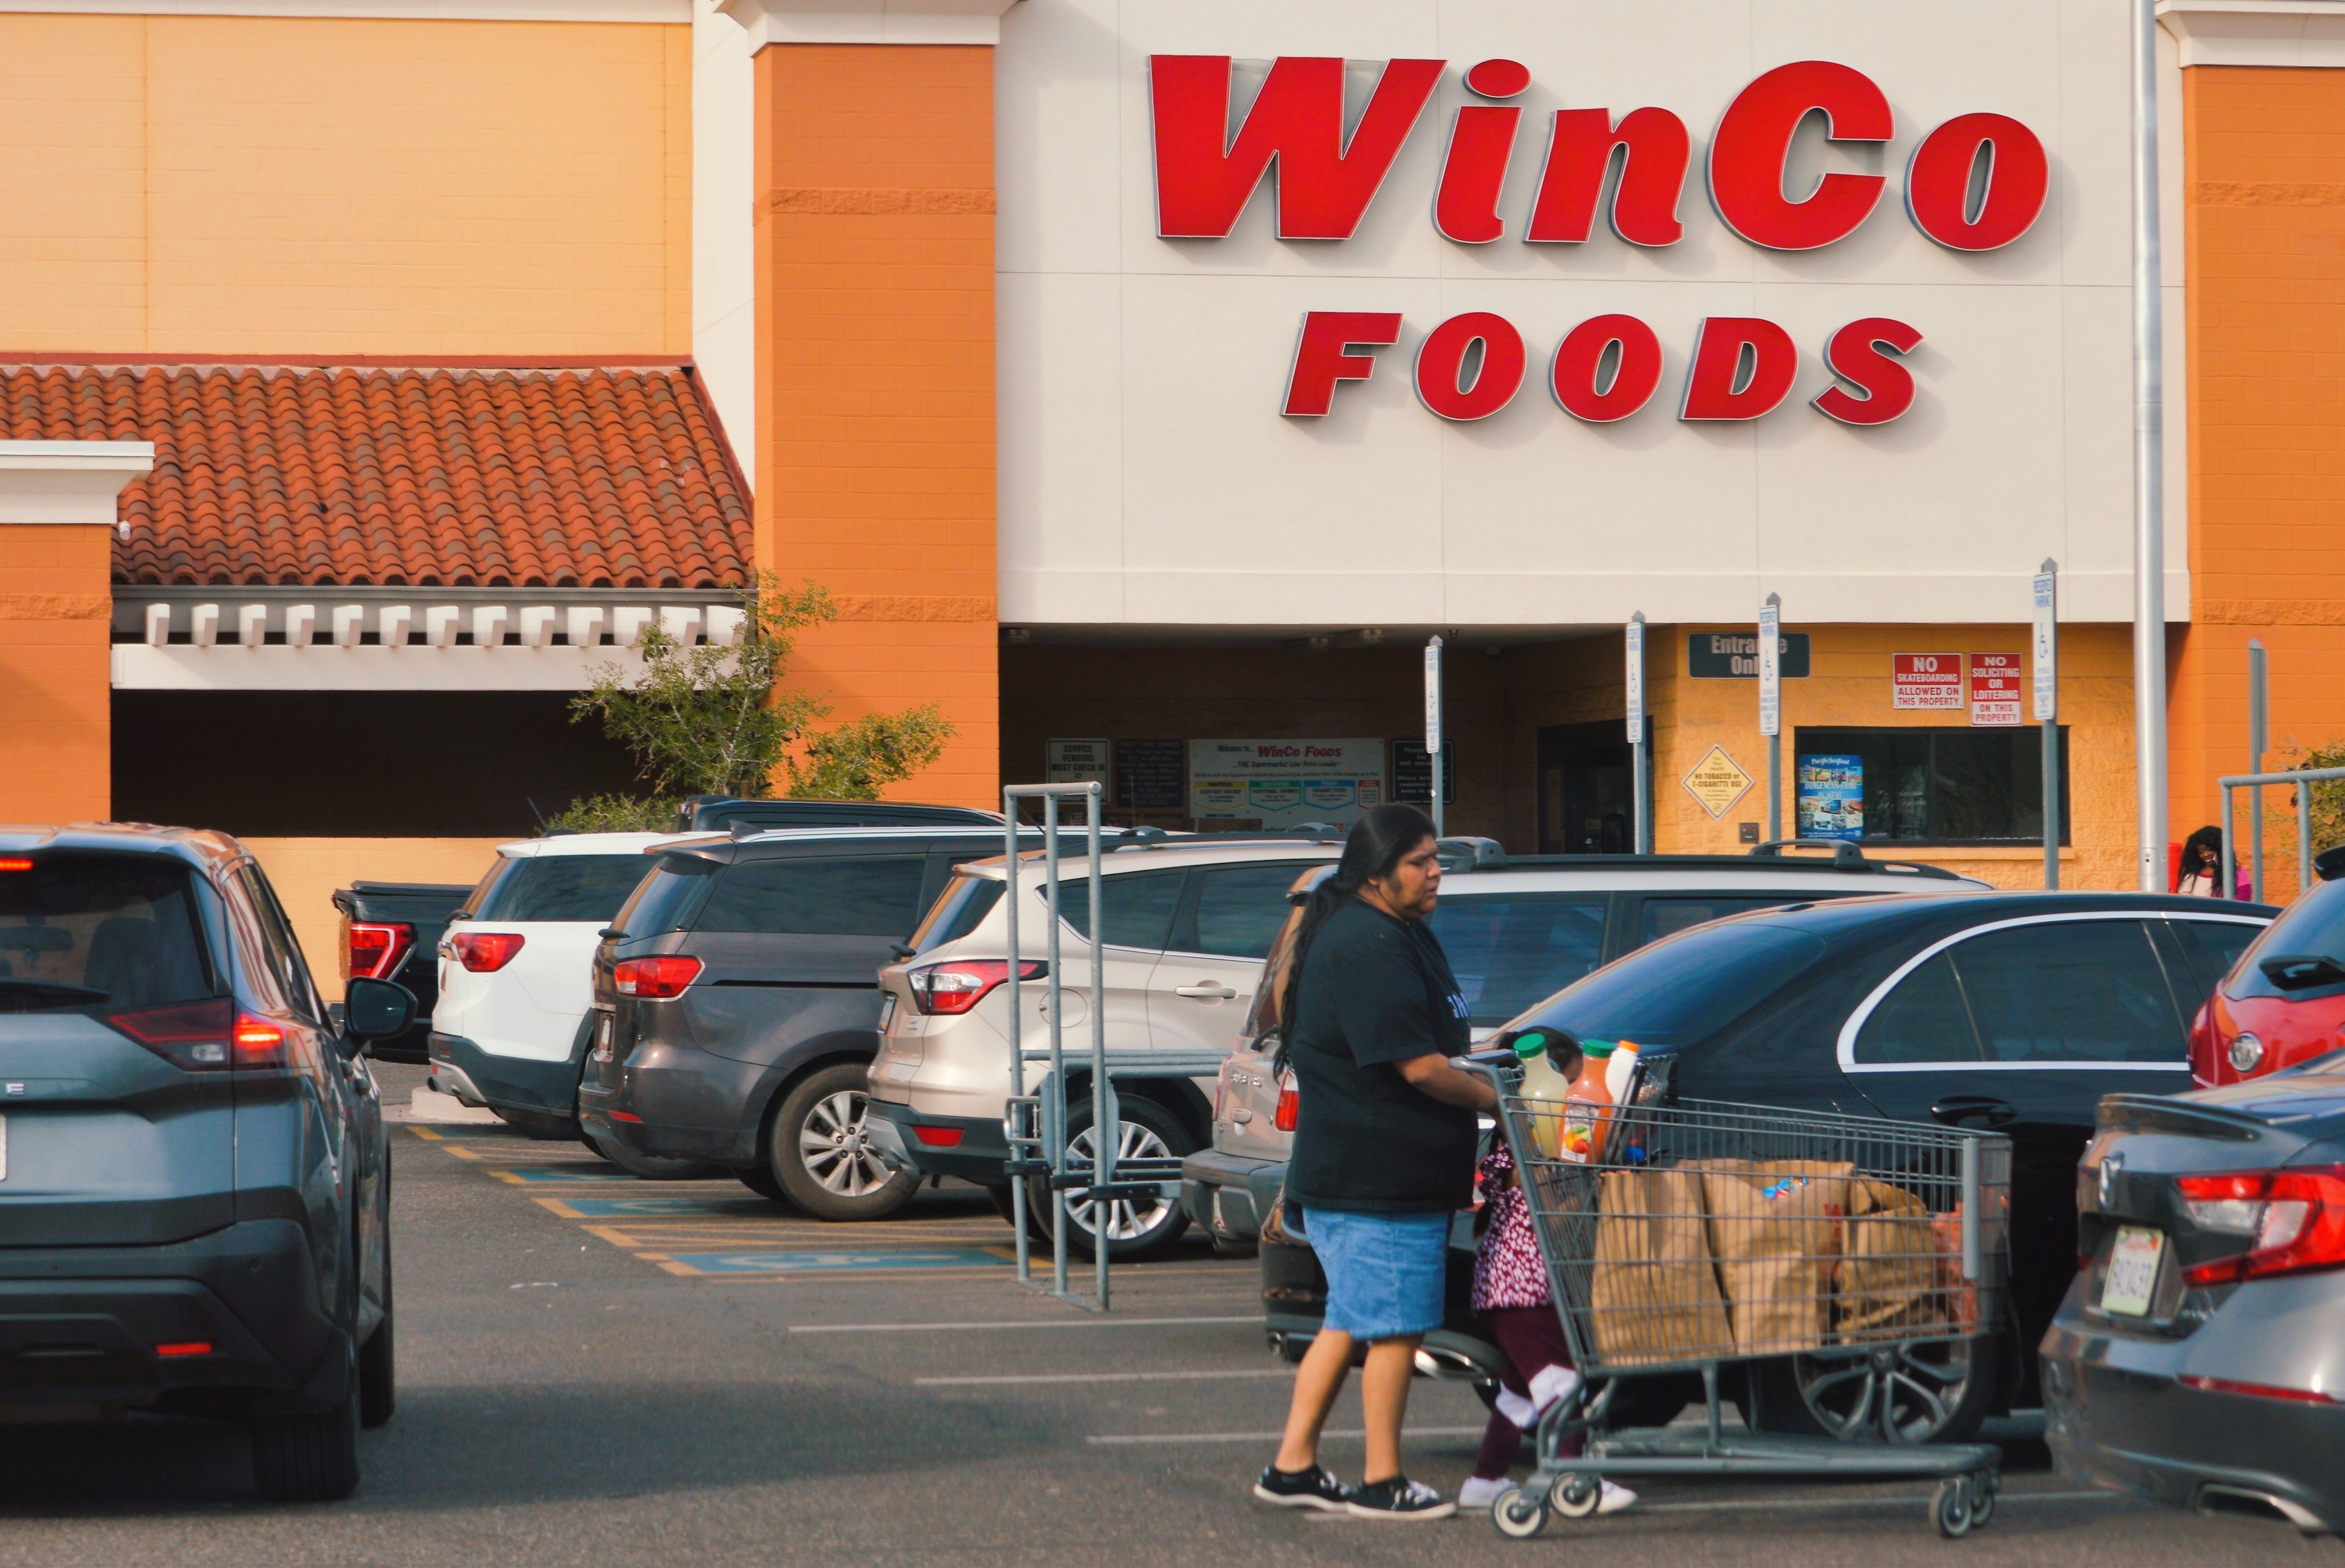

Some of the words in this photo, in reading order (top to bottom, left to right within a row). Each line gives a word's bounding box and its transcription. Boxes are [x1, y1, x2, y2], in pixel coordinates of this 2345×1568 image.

[1147, 56, 2049, 250] WinCo
[1282, 312, 1925, 425] FOODS
[1711, 635, 1788, 654] Entrae
[1731, 655, 1760, 675] Onl
[1914, 657, 1938, 672] NO
[1984, 657, 2007, 666] NO
[1898, 673, 1958, 682] SKATEBOARDING
[1972, 668, 2019, 678] SOLICITING
[1989, 679, 2003, 688] OR
[1973, 690, 2019, 699] LOITERING
[1258, 745, 1300, 757] WinCo
